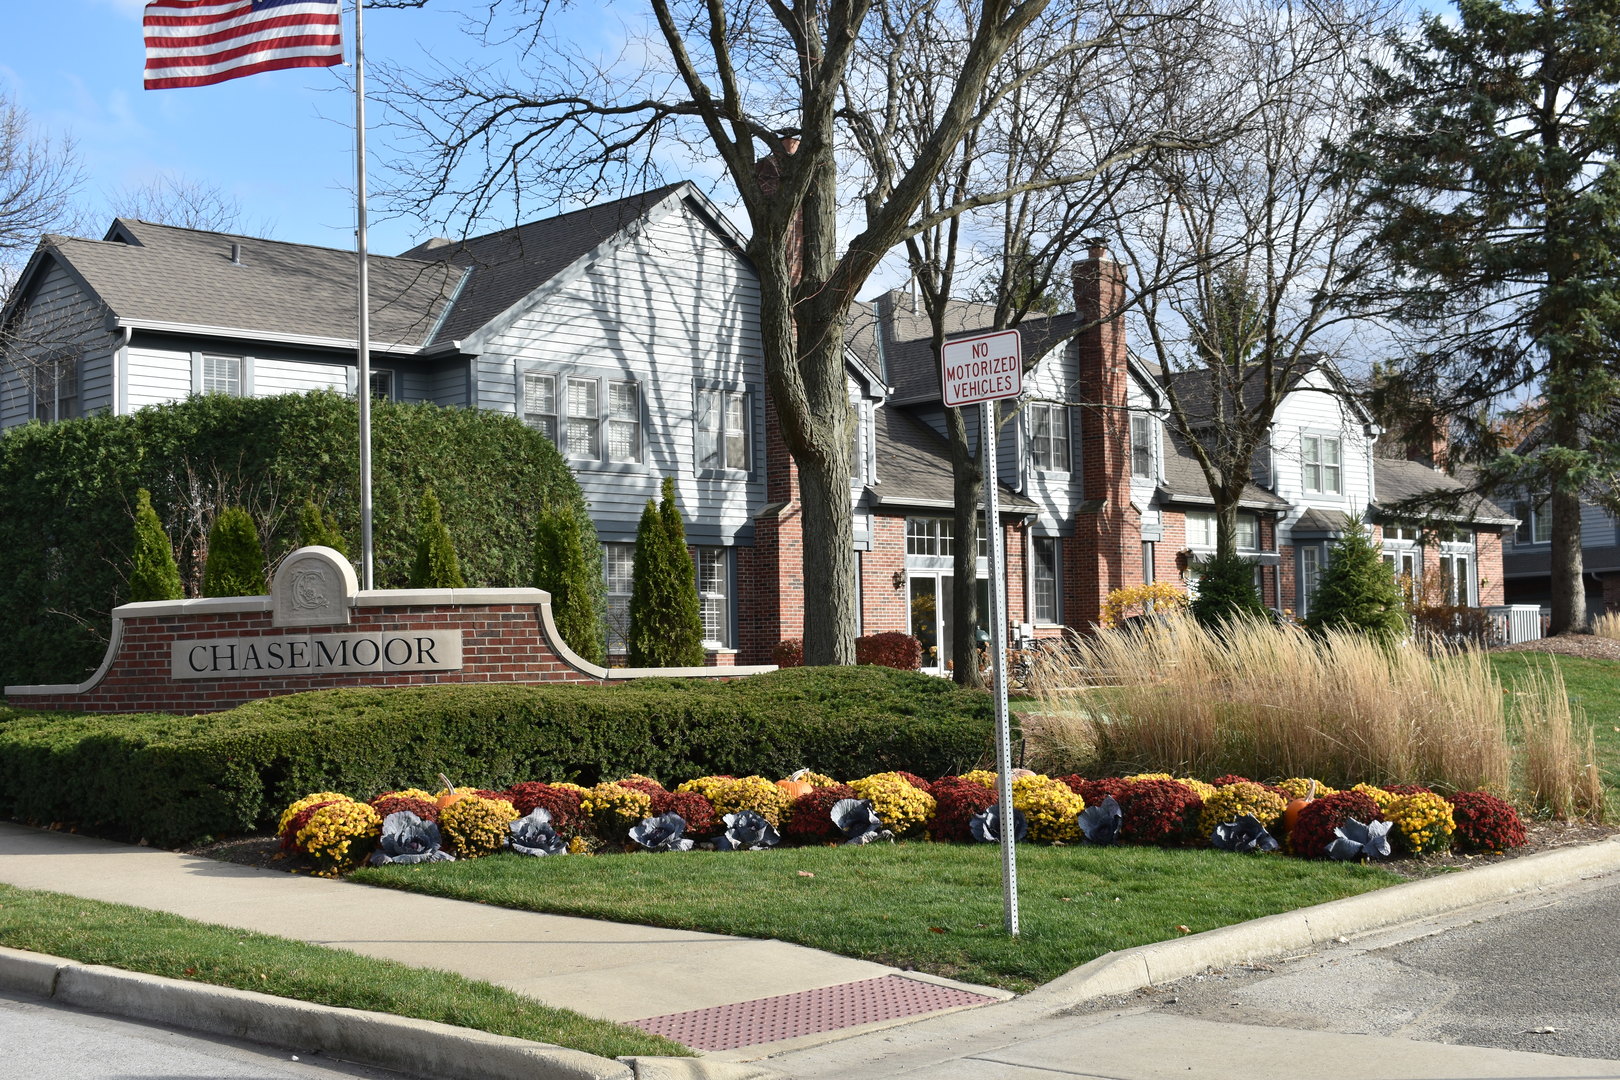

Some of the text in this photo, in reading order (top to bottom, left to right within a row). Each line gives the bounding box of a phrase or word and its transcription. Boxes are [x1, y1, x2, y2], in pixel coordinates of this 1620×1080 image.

[972, 342, 988, 359] NO
[947, 356, 1016, 382] MOTORIZED
[953, 375, 1012, 399] VEHICLES
[188, 637, 439, 672] CHASEMOOR
